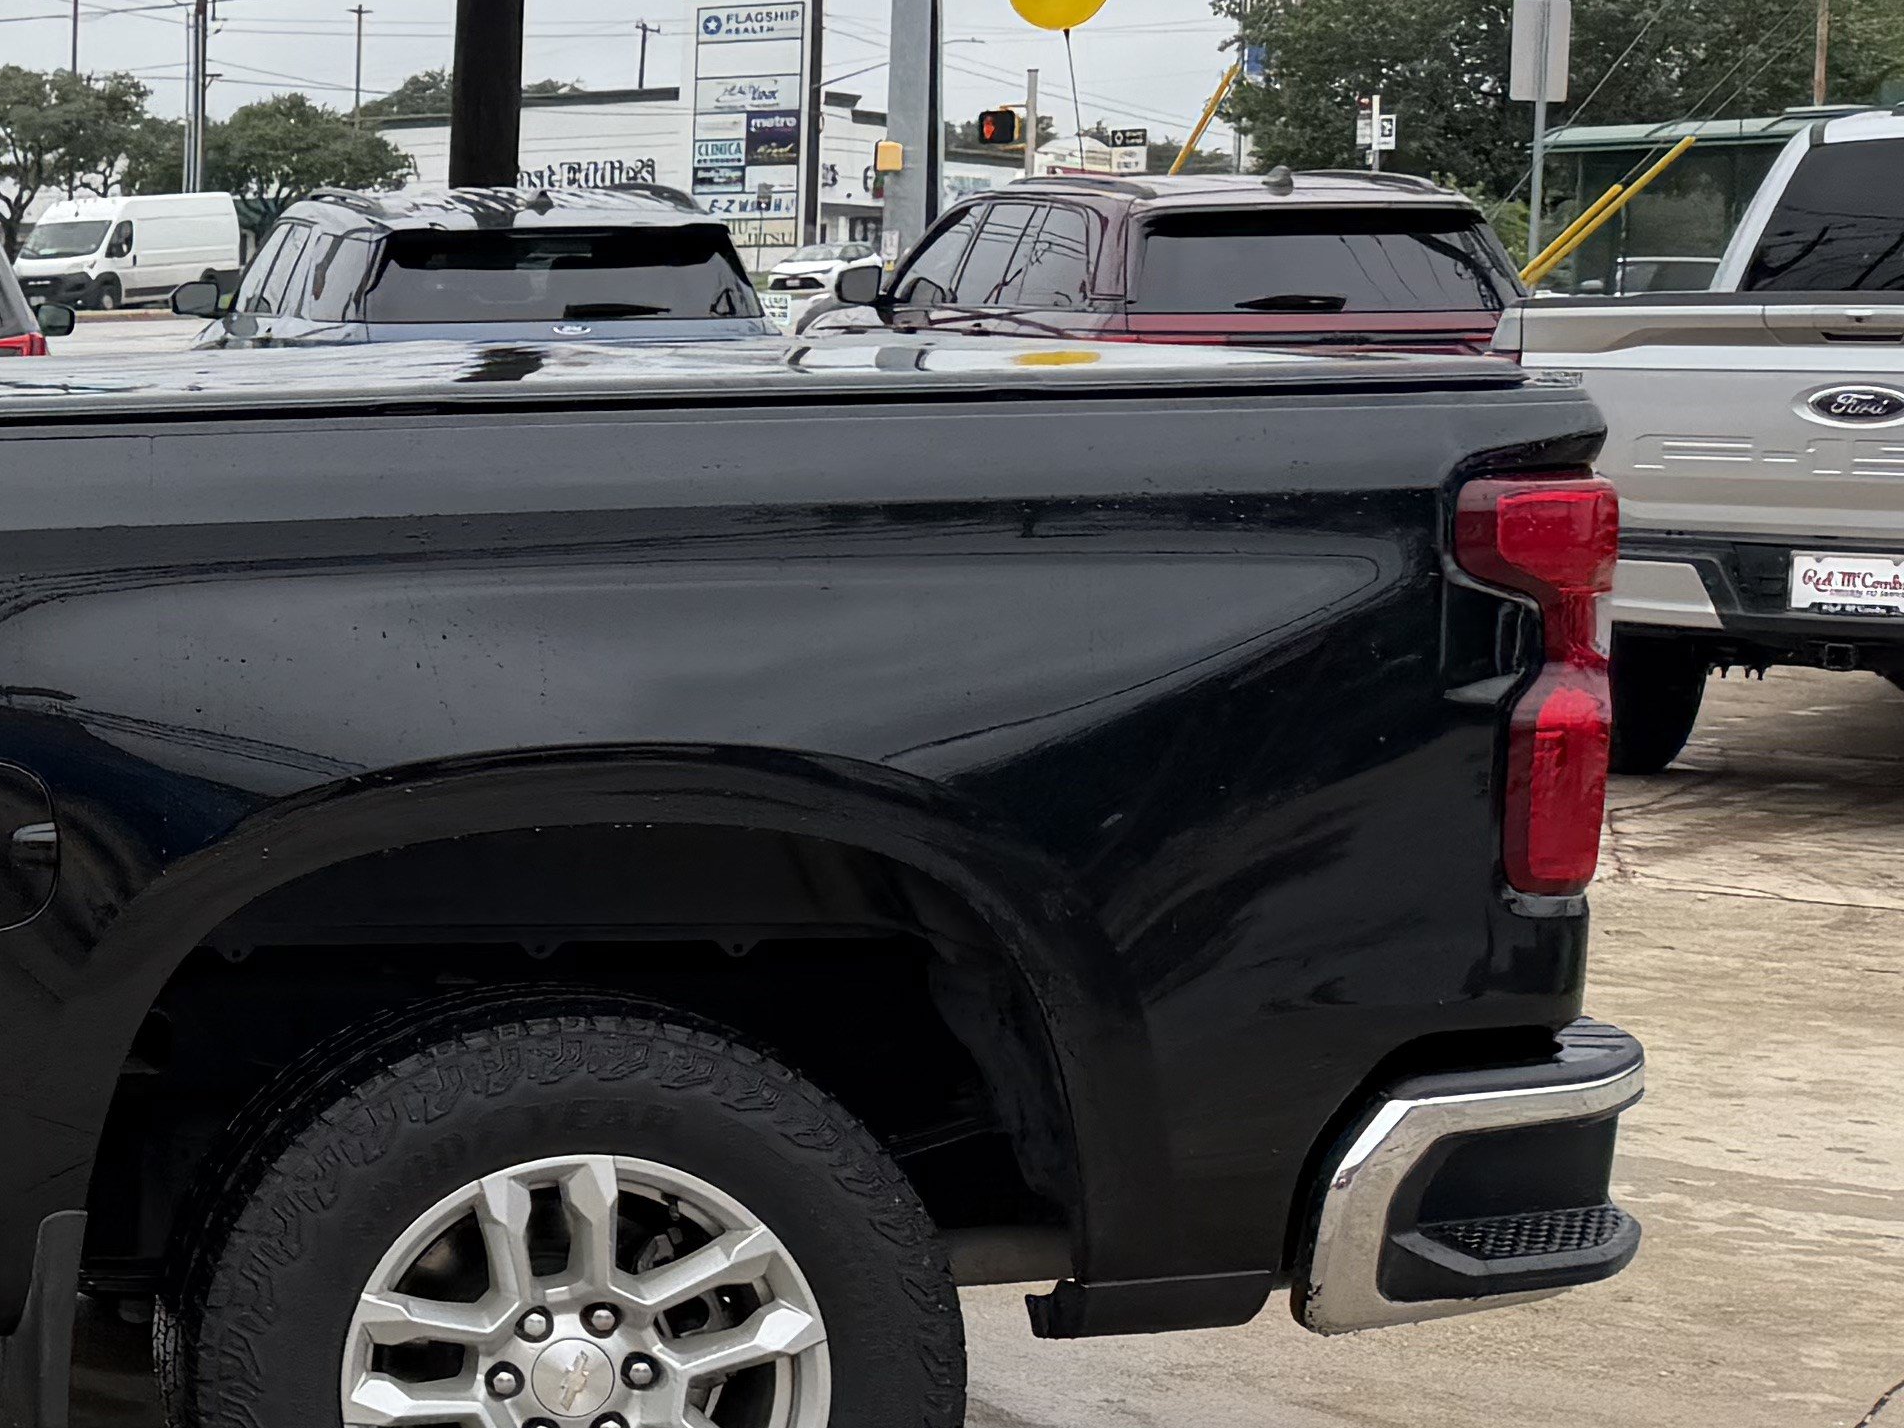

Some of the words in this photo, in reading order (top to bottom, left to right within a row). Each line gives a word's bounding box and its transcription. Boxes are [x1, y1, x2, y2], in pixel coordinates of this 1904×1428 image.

[726, 10, 799, 25] FLAGSHIP
[1830, 393, 1890, 415] Ford
[1802, 568, 1835, 592] Red
